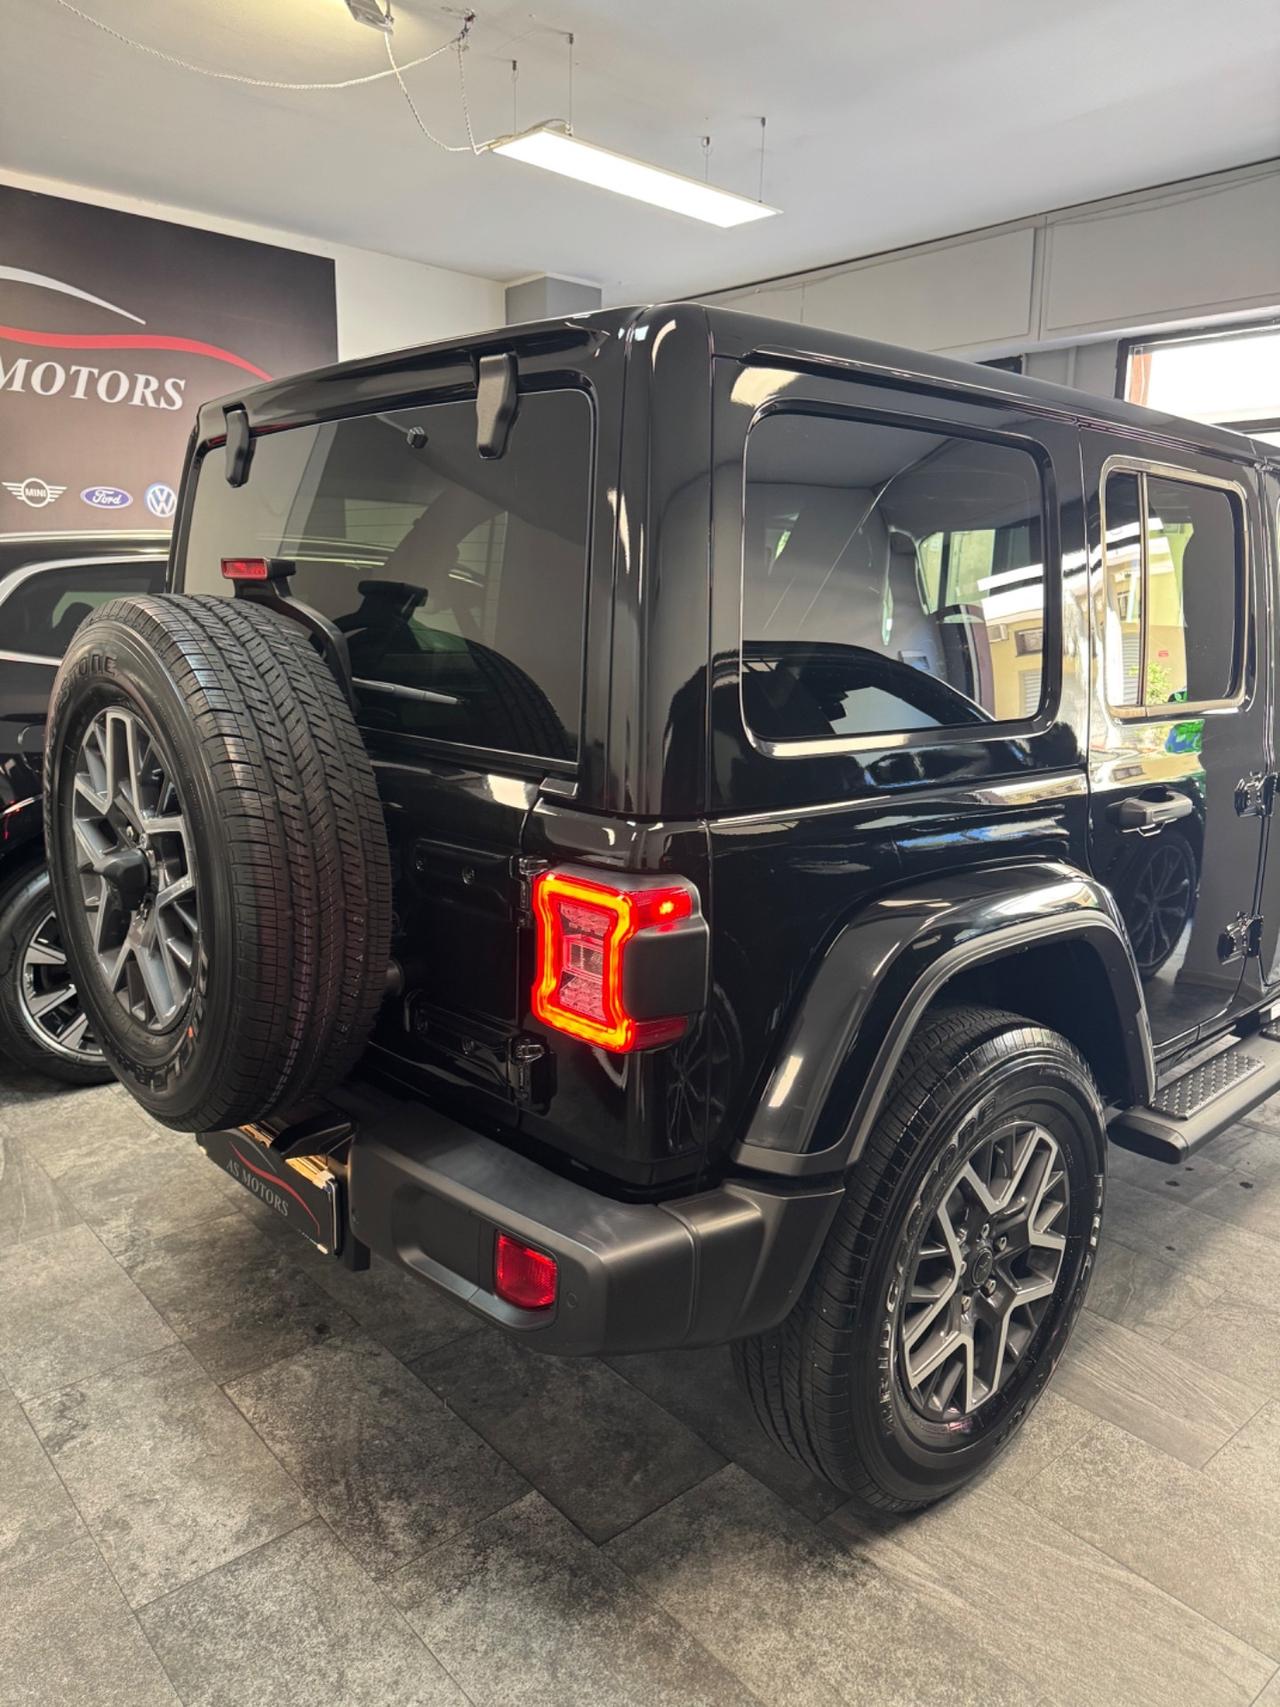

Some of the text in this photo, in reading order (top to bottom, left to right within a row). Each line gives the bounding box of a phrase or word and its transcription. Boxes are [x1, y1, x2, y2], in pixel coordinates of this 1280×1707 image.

[25, 487, 46, 498] MINI
[92, 490, 122, 505] Ford
[226, 1159, 289, 1217] AS MOTORS
